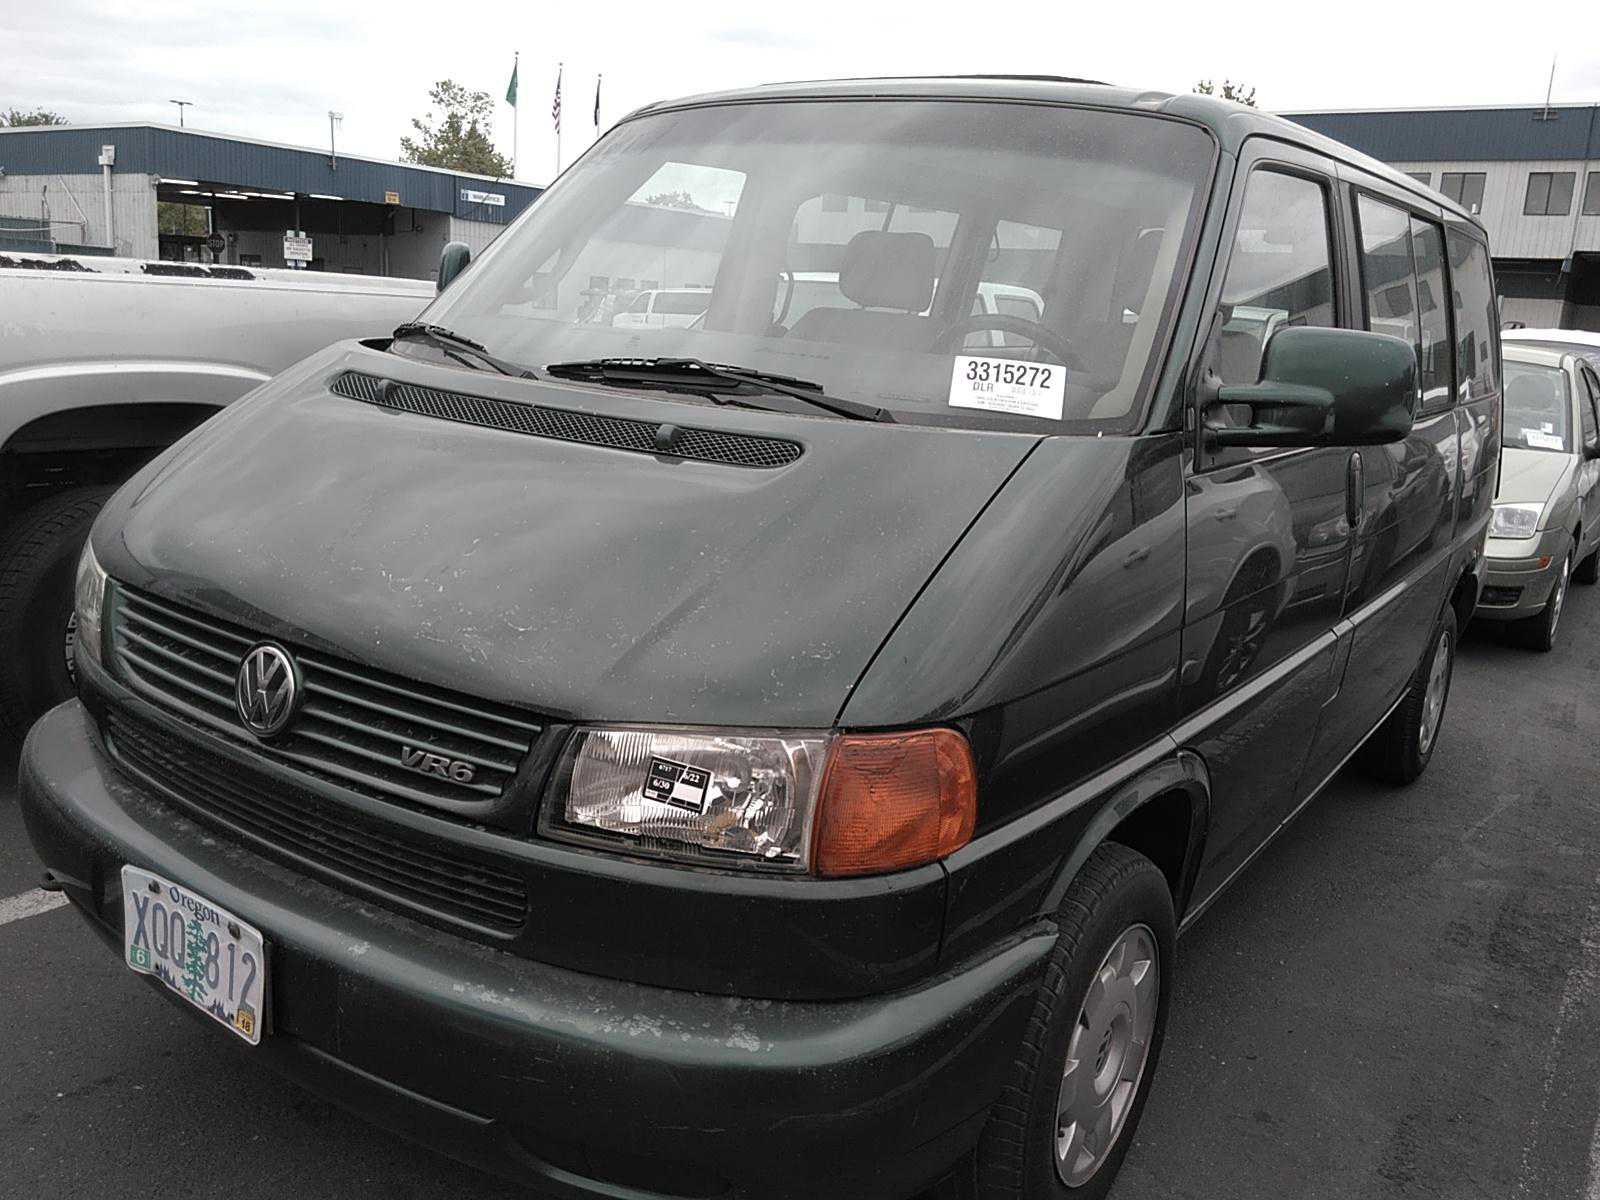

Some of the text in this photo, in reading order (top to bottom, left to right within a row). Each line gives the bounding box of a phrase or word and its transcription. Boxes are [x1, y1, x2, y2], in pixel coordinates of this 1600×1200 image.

[966, 361, 1052, 389] 3315272
[972, 381, 994, 393] DLR
[401, 745, 477, 783] VR6
[169, 886, 221, 926] Oregon
[206, 931, 257, 1008] 812
